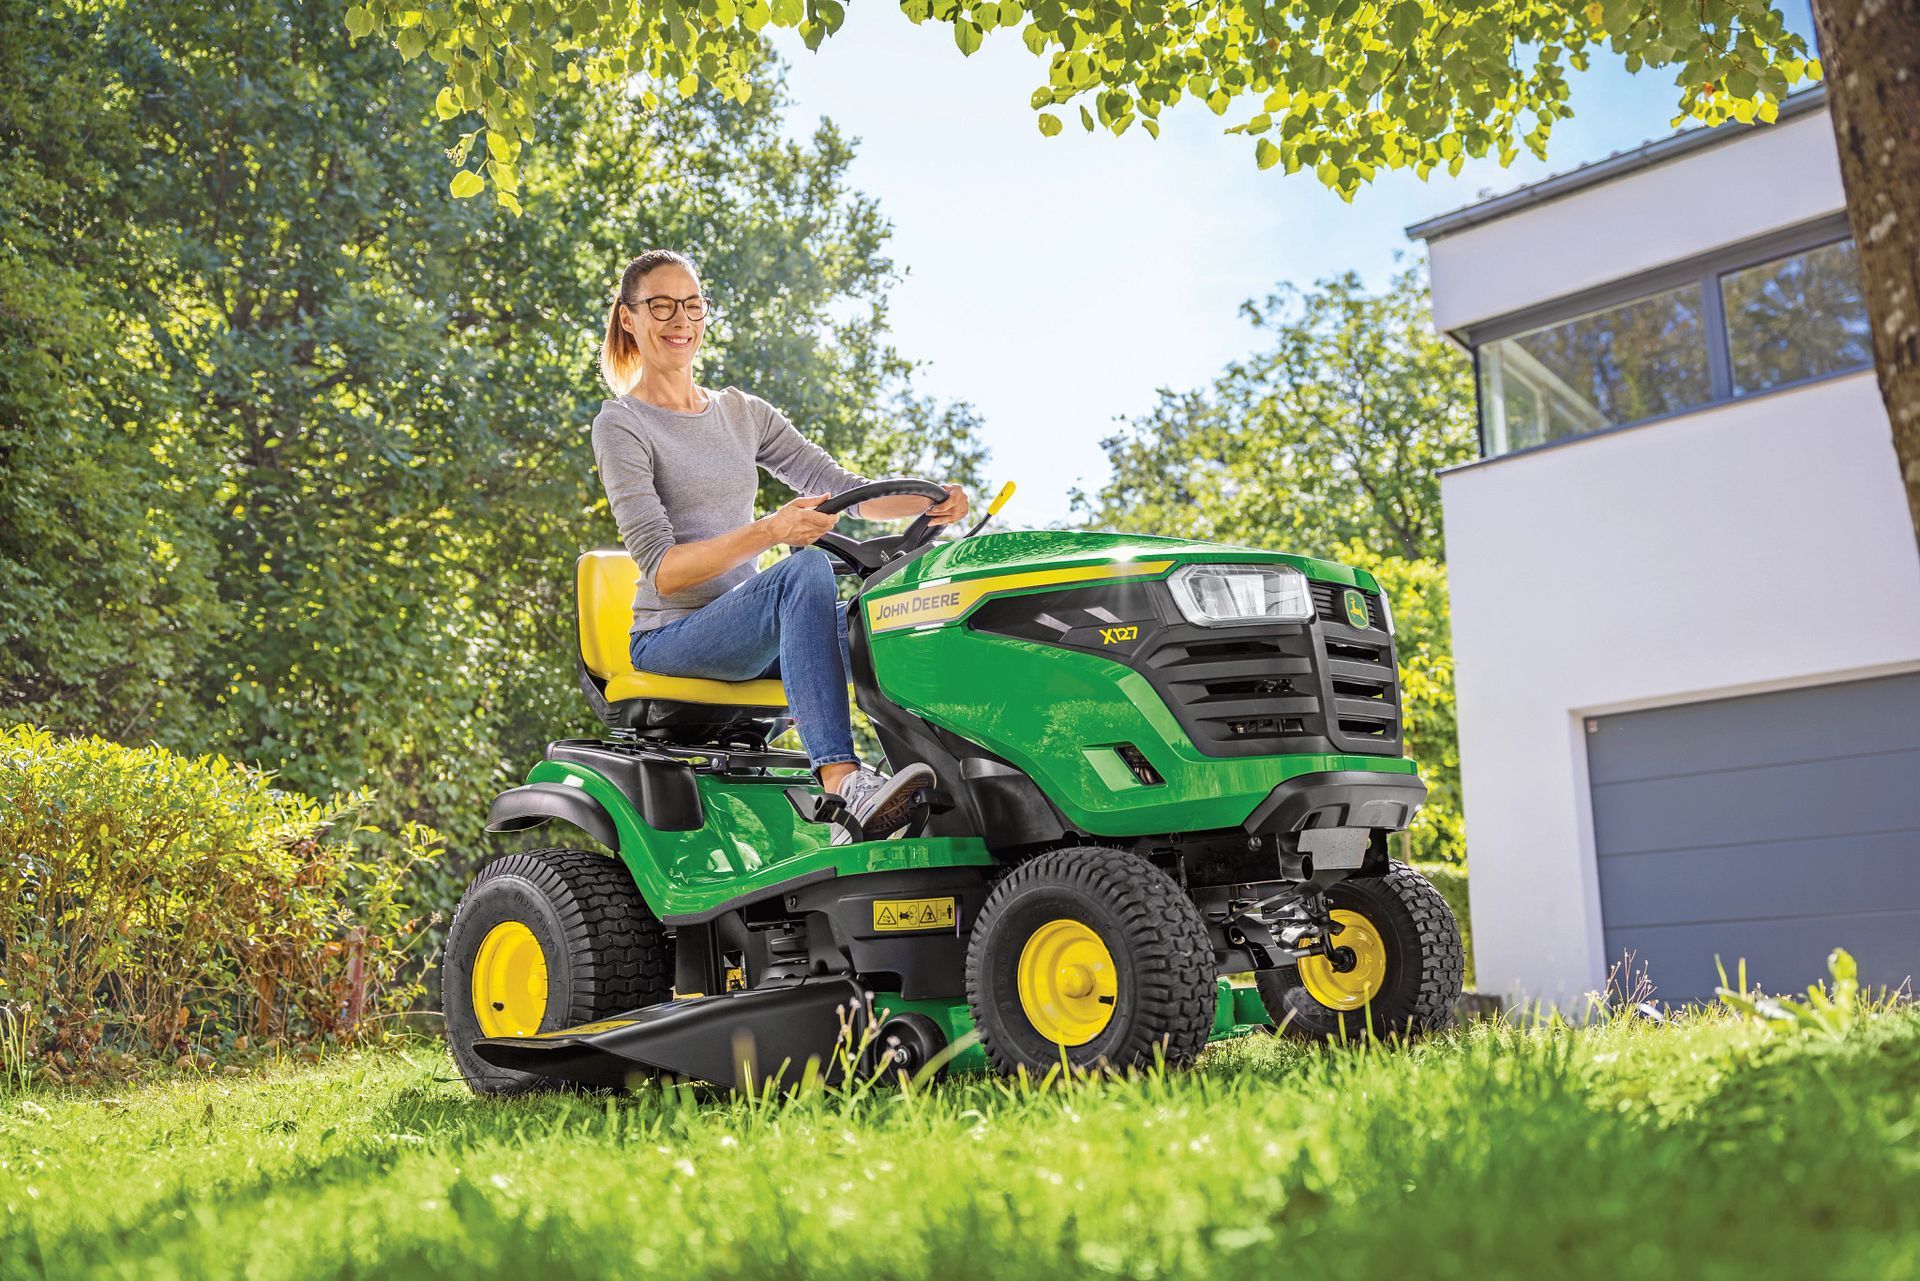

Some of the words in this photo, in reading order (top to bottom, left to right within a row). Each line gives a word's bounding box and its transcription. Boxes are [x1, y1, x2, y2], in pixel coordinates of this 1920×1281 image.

[876, 602, 909, 621] JOHN
[911, 592, 960, 612] DEERE
[1098, 626, 1139, 645] X127
